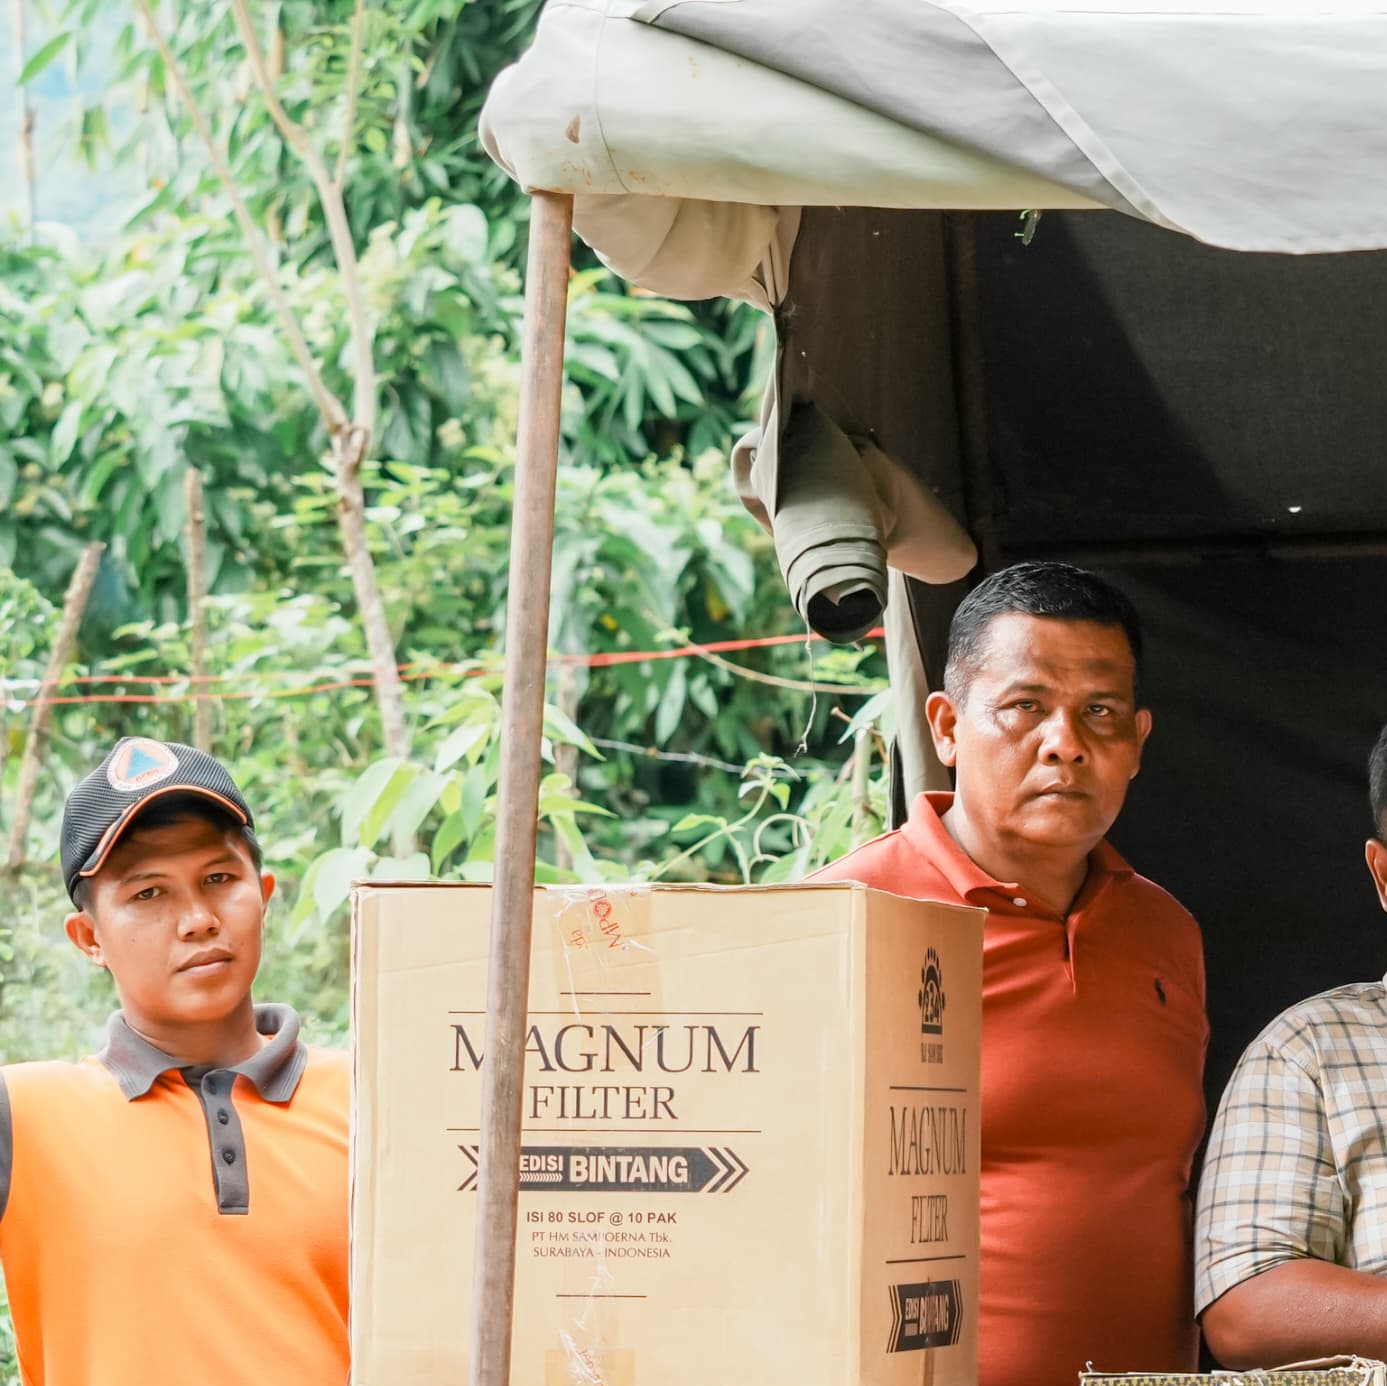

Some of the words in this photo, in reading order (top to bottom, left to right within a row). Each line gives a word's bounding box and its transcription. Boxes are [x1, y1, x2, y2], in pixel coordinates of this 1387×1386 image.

[529, 1086, 678, 1120] FILTER
[889, 1107, 967, 1176] MAGNUM
[520, 1155, 563, 1171] EDISI
[569, 1155, 688, 1183] BINTANG
[527, 1212, 544, 1223] ISI
[548, 1212, 563, 1224] 80
[568, 1212, 604, 1224] SLOF
[628, 1213, 643, 1224] 10
[647, 1213, 676, 1224] PAK
[911, 1195, 948, 1243] FILTER
[532, 1232, 544, 1241] PT
[549, 1232, 568, 1241] HM
[533, 1247, 594, 1257] SURABAYA
[604, 1247, 670, 1258] INDONESIA
